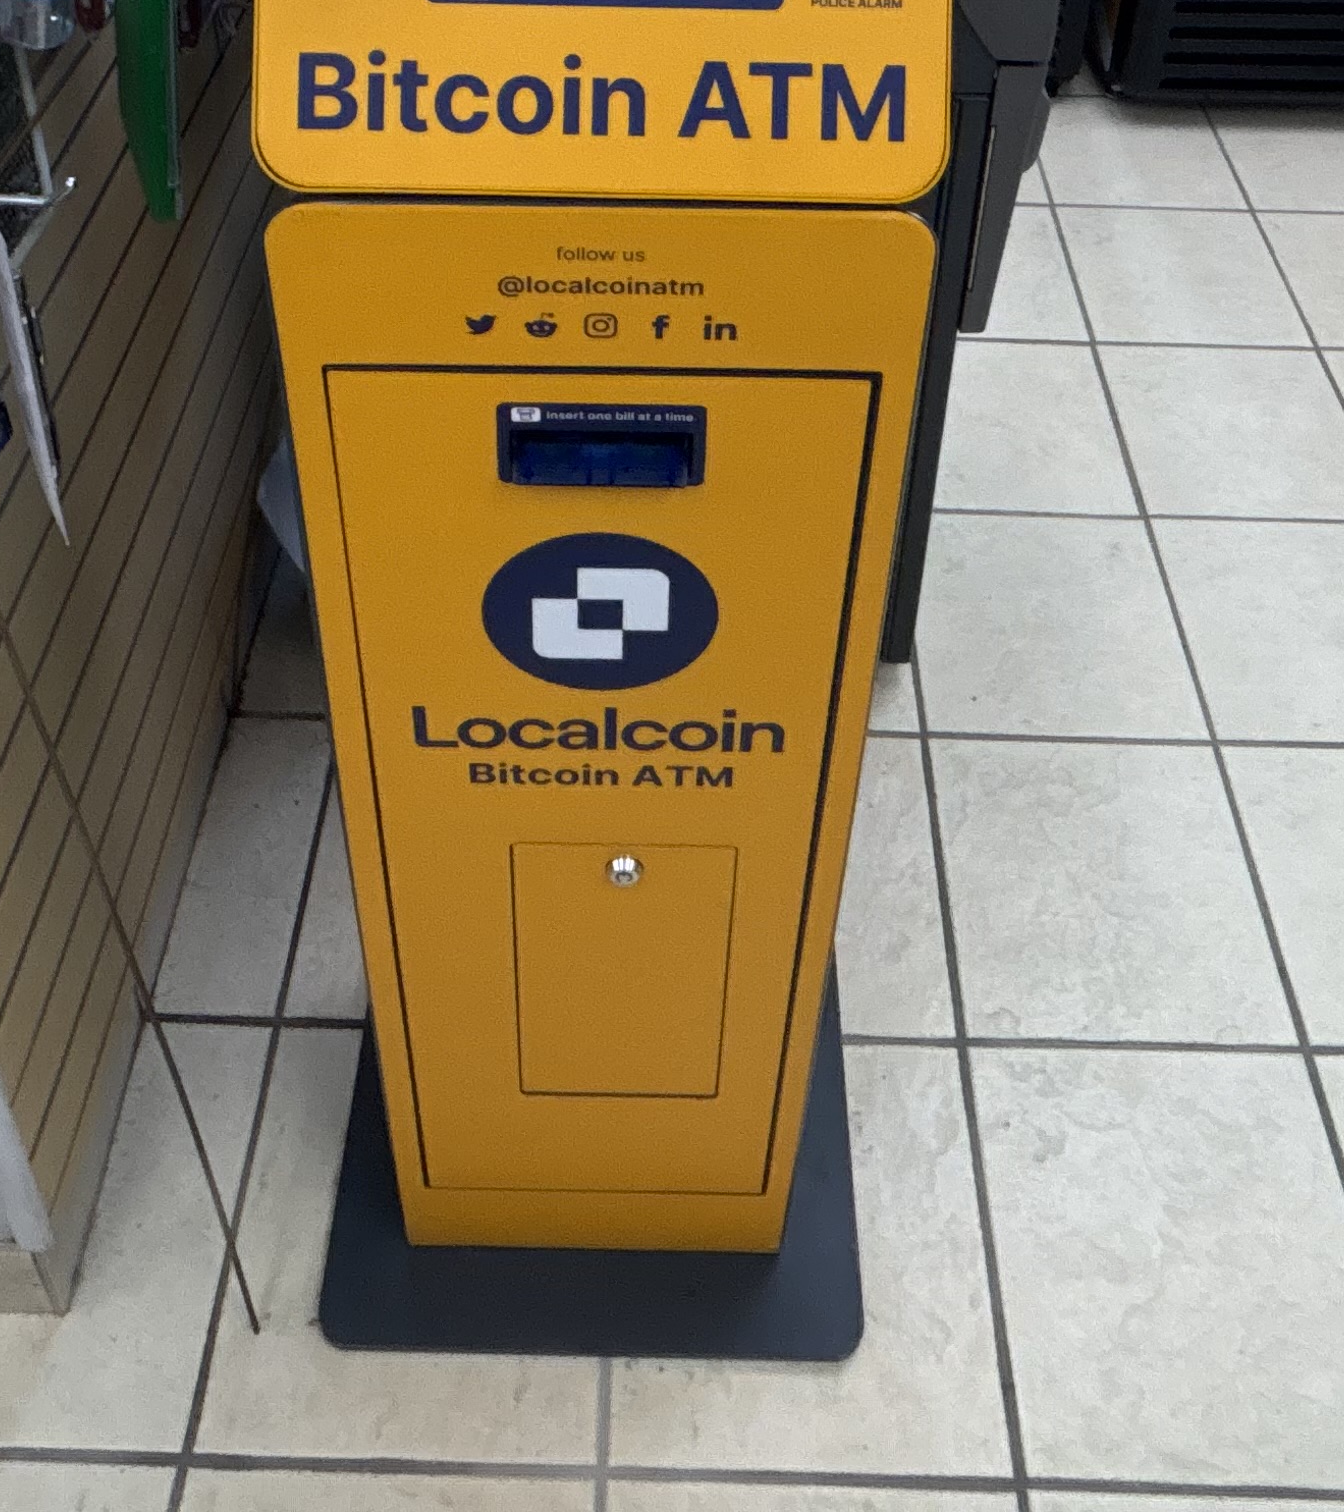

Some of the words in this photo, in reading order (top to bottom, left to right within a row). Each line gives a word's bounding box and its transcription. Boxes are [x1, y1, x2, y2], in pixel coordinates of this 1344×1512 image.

[296, 49, 647, 137] Bitcoin
[678, 60, 907, 143] ATM
[556, 246, 616, 262] follow
[622, 249, 646, 262] us
[497, 275, 705, 297] @localcoinatm
[546, 411, 584, 420] Insert
[587, 412, 612, 421] one
[615, 411, 635, 421] bill
[638, 412, 649, 422] at
[665, 413, 694, 423] time
[412, 705, 785, 754] Localcoin
[468, 763, 619, 786] Bitcoin
[632, 764, 735, 788] ATM
